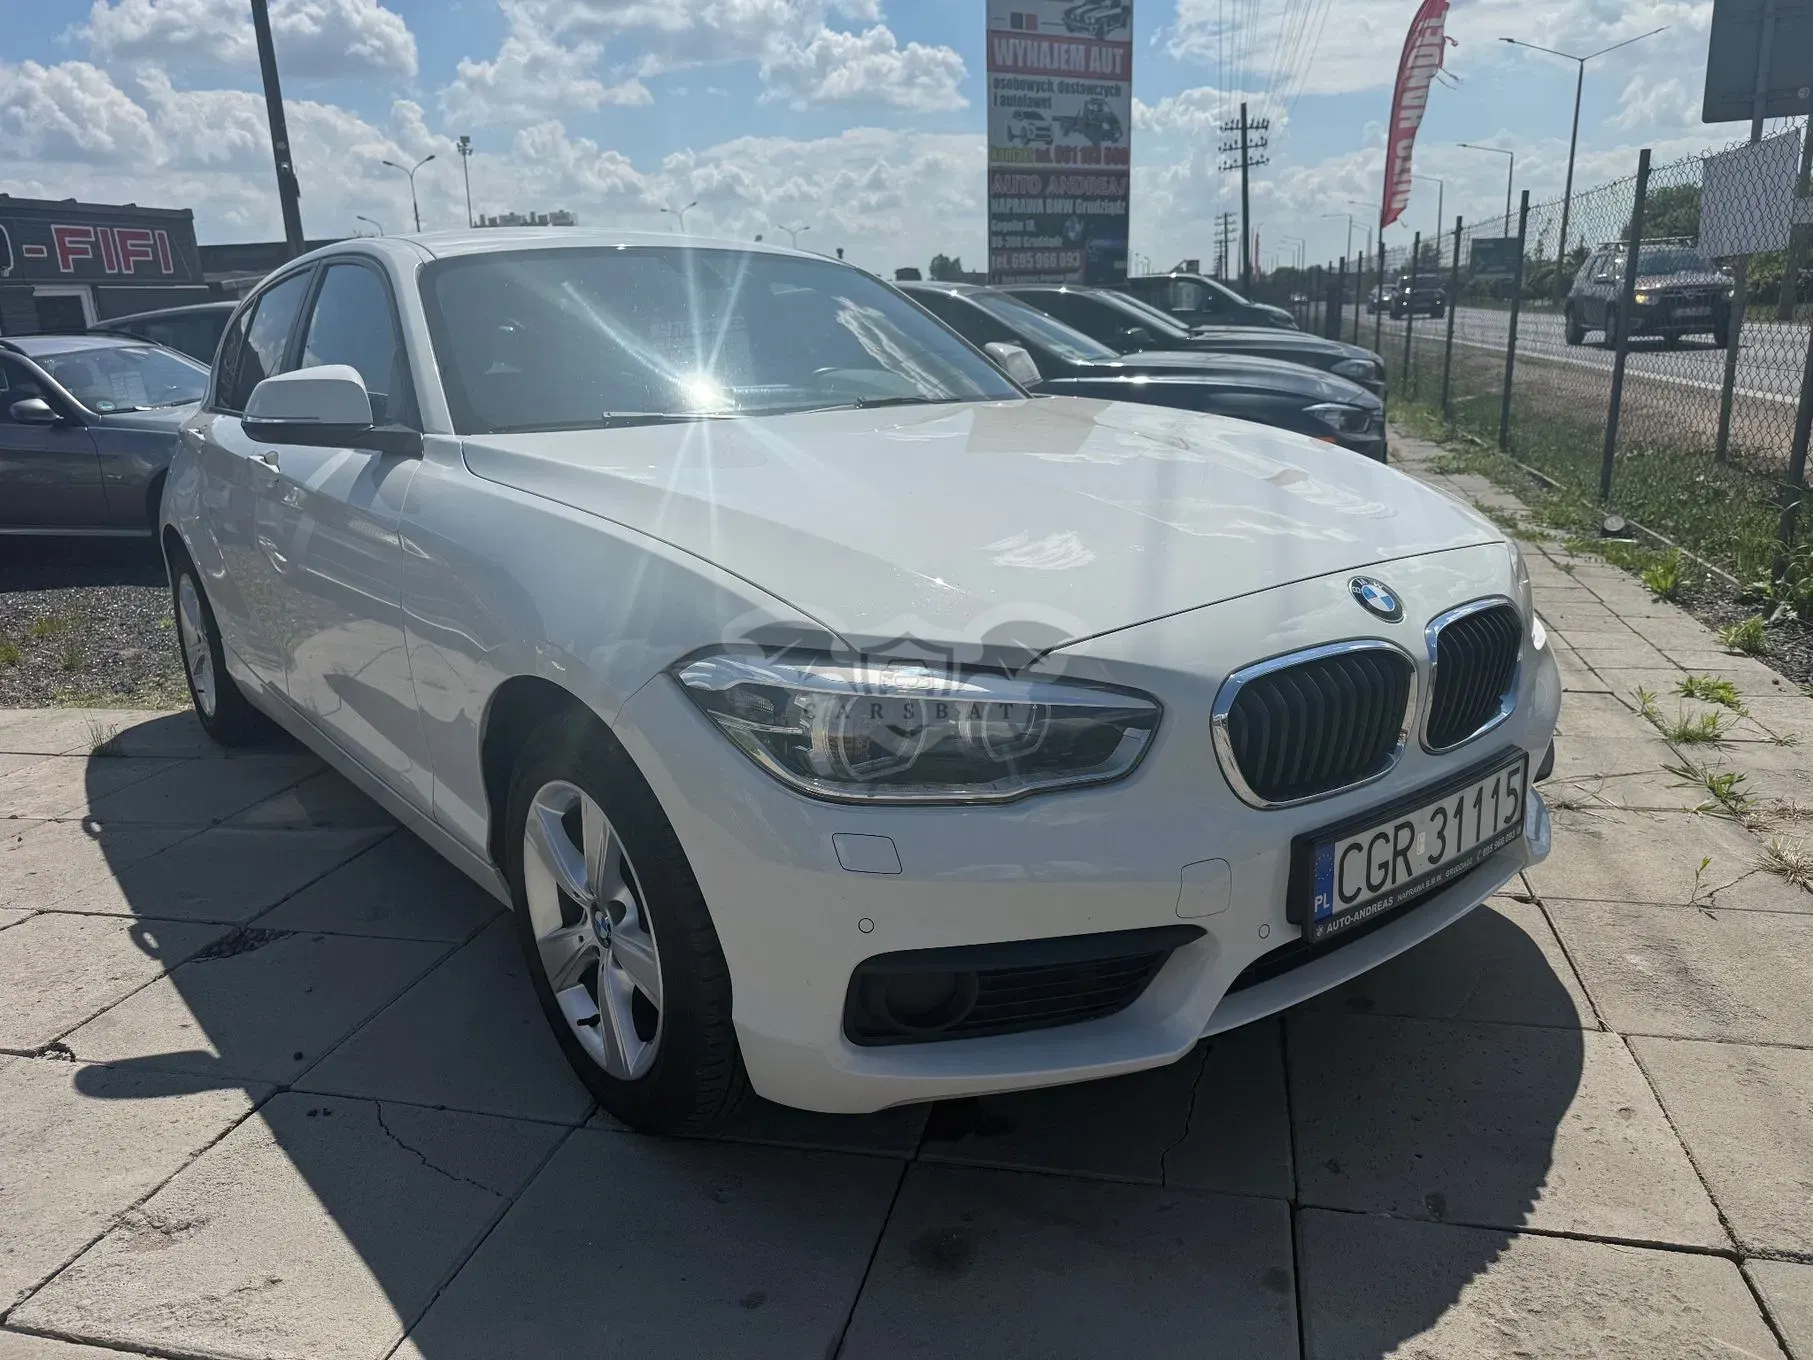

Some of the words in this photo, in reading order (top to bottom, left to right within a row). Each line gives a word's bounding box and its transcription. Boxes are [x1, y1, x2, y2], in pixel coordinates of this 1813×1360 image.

[993, 37, 1086, 72] WYNAJEM
[1089, 46, 1124, 74] AUT
[1398, 10, 1445, 128] HANDEL
[1057, 79, 1122, 98] dostawczych
[992, 174, 1043, 195] AUTO
[990, 198, 1044, 214] NAPRAWA
[1046, 198, 1074, 214] BMW
[1012, 253, 1035, 269] 695
[1036, 252, 1058, 269] 966
[1060, 252, 1081, 268] 093
[1338, 821, 1415, 904] CGR
[1428, 766, 1520, 865] 31115
[1315, 893, 1330, 912] PL
[1326, 896, 1394, 933] AUTO-ANDREAS
